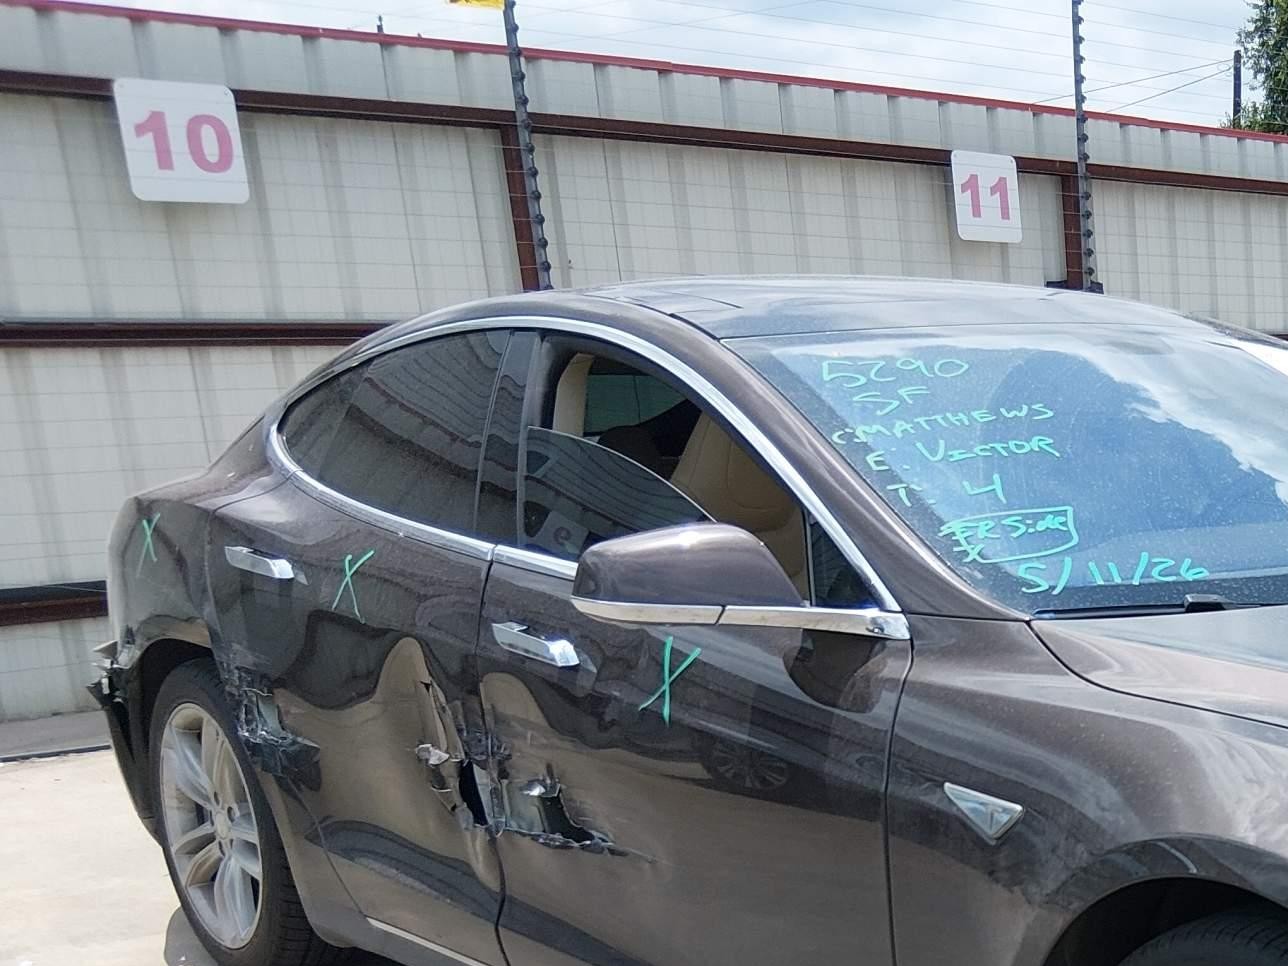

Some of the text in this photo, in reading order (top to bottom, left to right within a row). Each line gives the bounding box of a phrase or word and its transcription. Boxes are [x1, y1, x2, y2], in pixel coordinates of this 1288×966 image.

[134, 110, 235, 174] 10
[960, 173, 1011, 221] 11
[852, 385, 931, 416] SF
[856, 403, 1055, 442] MATTHEWS
[915, 436, 1061, 463] VICTOR
[961, 473, 1008, 505] 4
[1018, 552, 1210, 595] 5/11/26
